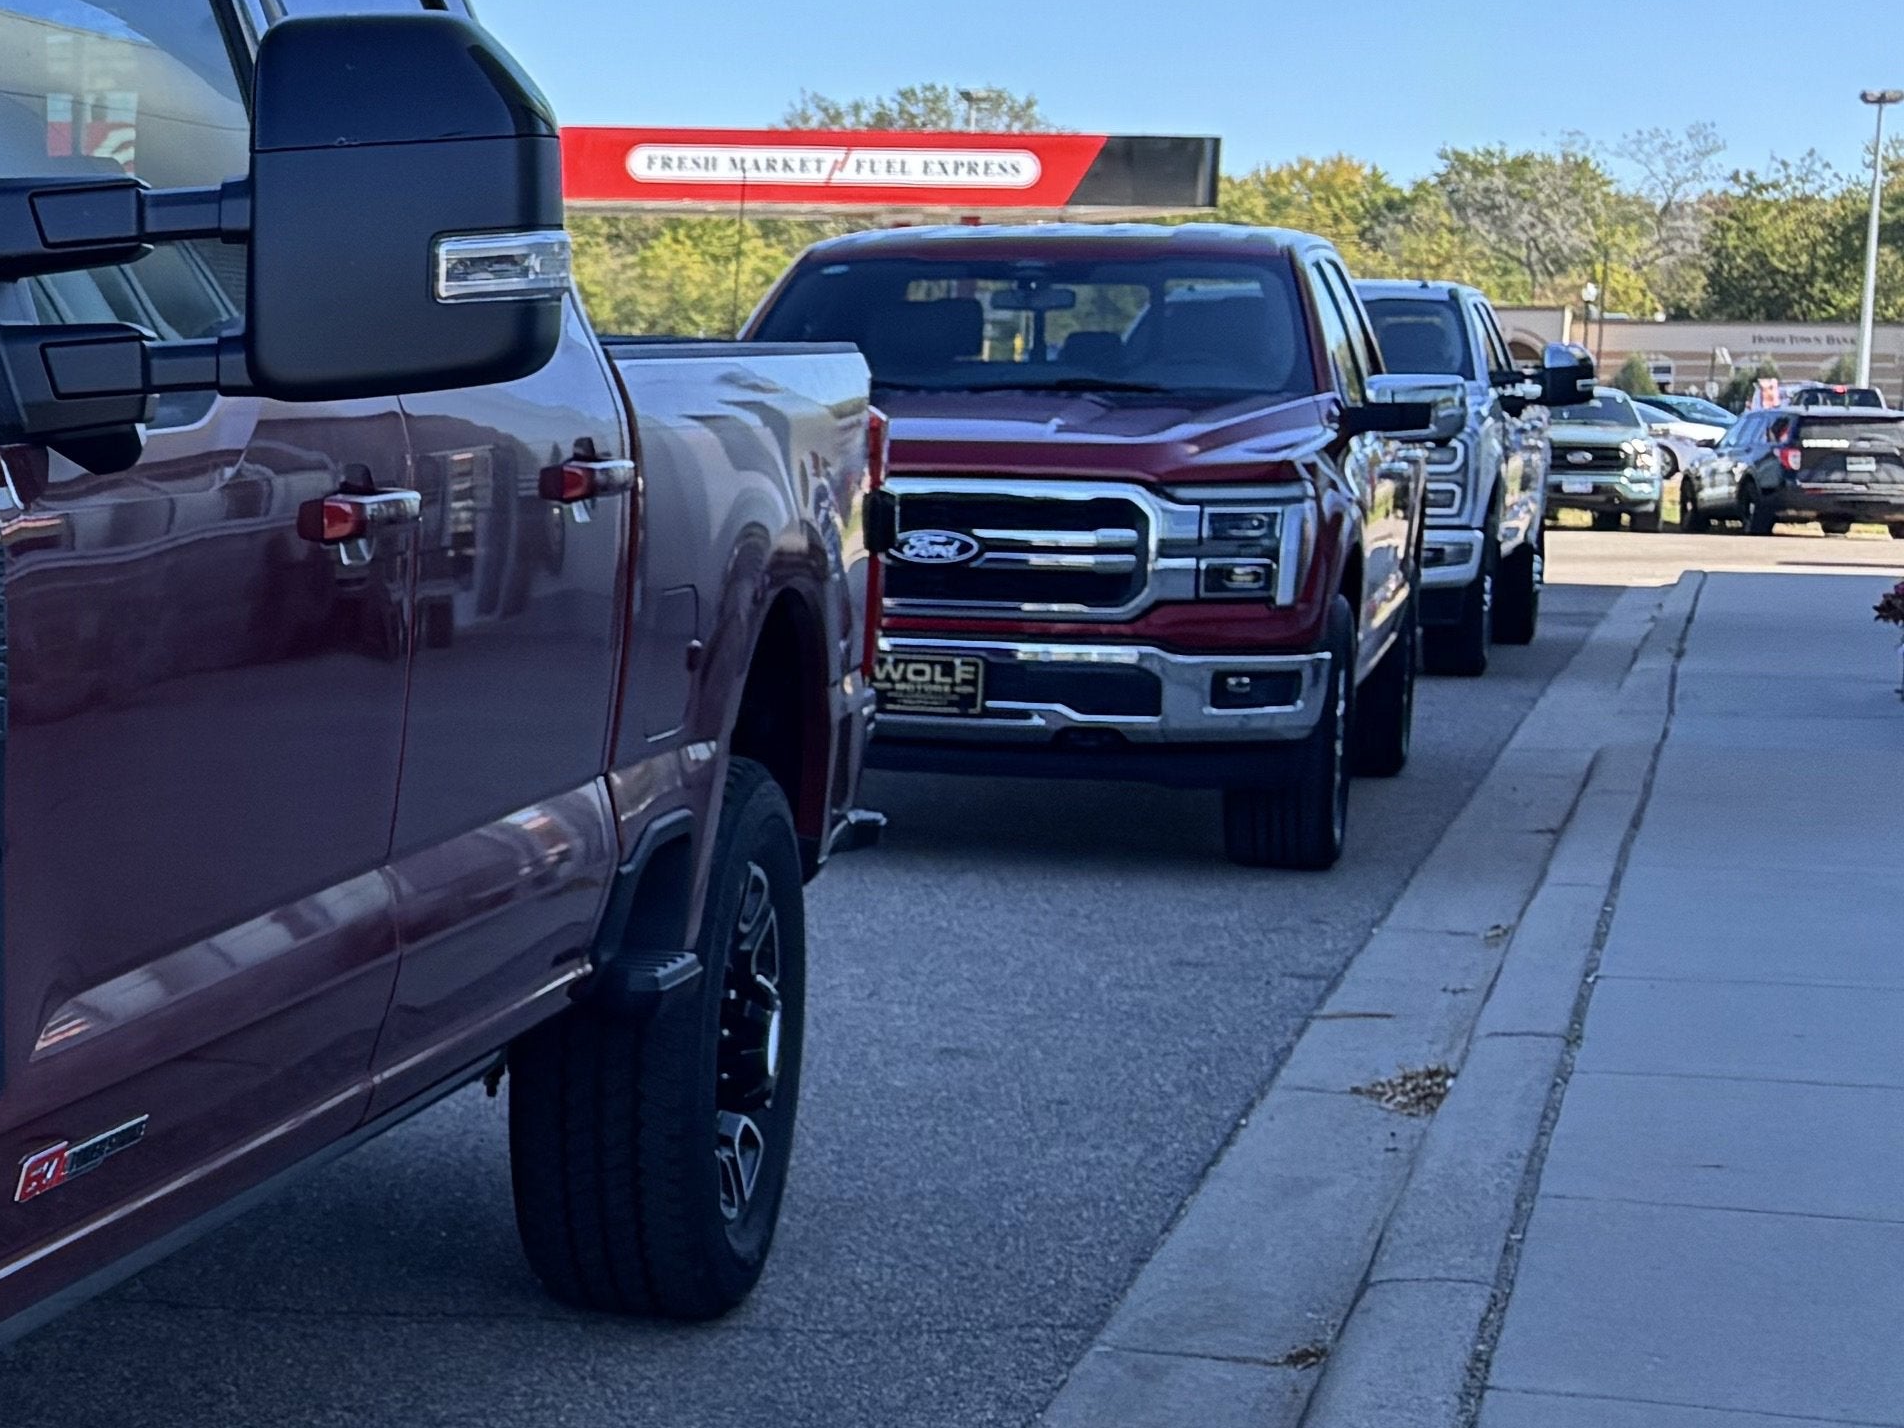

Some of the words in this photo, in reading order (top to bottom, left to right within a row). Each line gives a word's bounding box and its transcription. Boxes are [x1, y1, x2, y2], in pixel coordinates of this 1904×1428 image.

[646, 153, 719, 171] FRESH
[729, 155, 827, 174] MARKET
[855, 158, 913, 176] FUEL
[922, 160, 1022, 178] EXPRESS
[902, 533, 961, 560] Ford
[873, 661, 976, 684] WOLF
